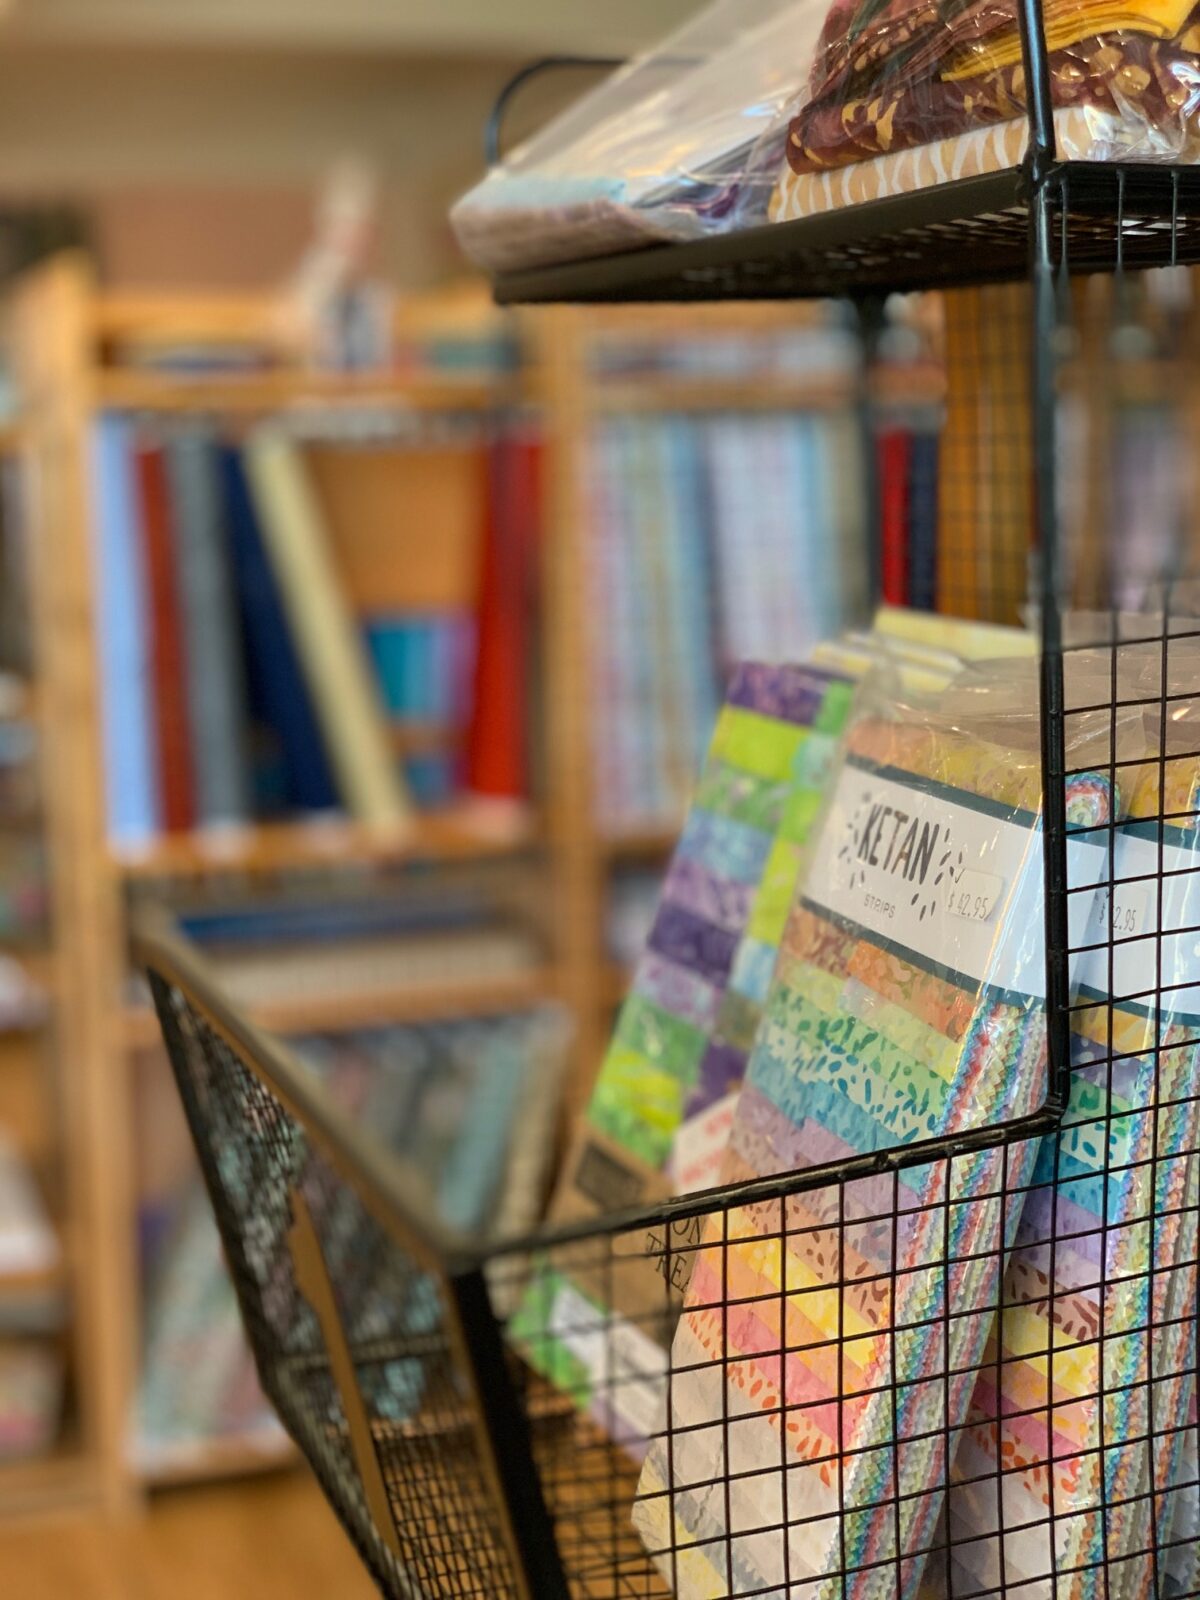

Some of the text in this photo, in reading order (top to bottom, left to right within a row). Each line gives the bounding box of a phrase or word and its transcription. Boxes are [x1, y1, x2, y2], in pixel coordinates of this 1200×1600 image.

[857, 803, 940, 885] KETAN
[864, 893, 896, 919] STRIPS
[1109, 904, 1137, 932] 2.95
